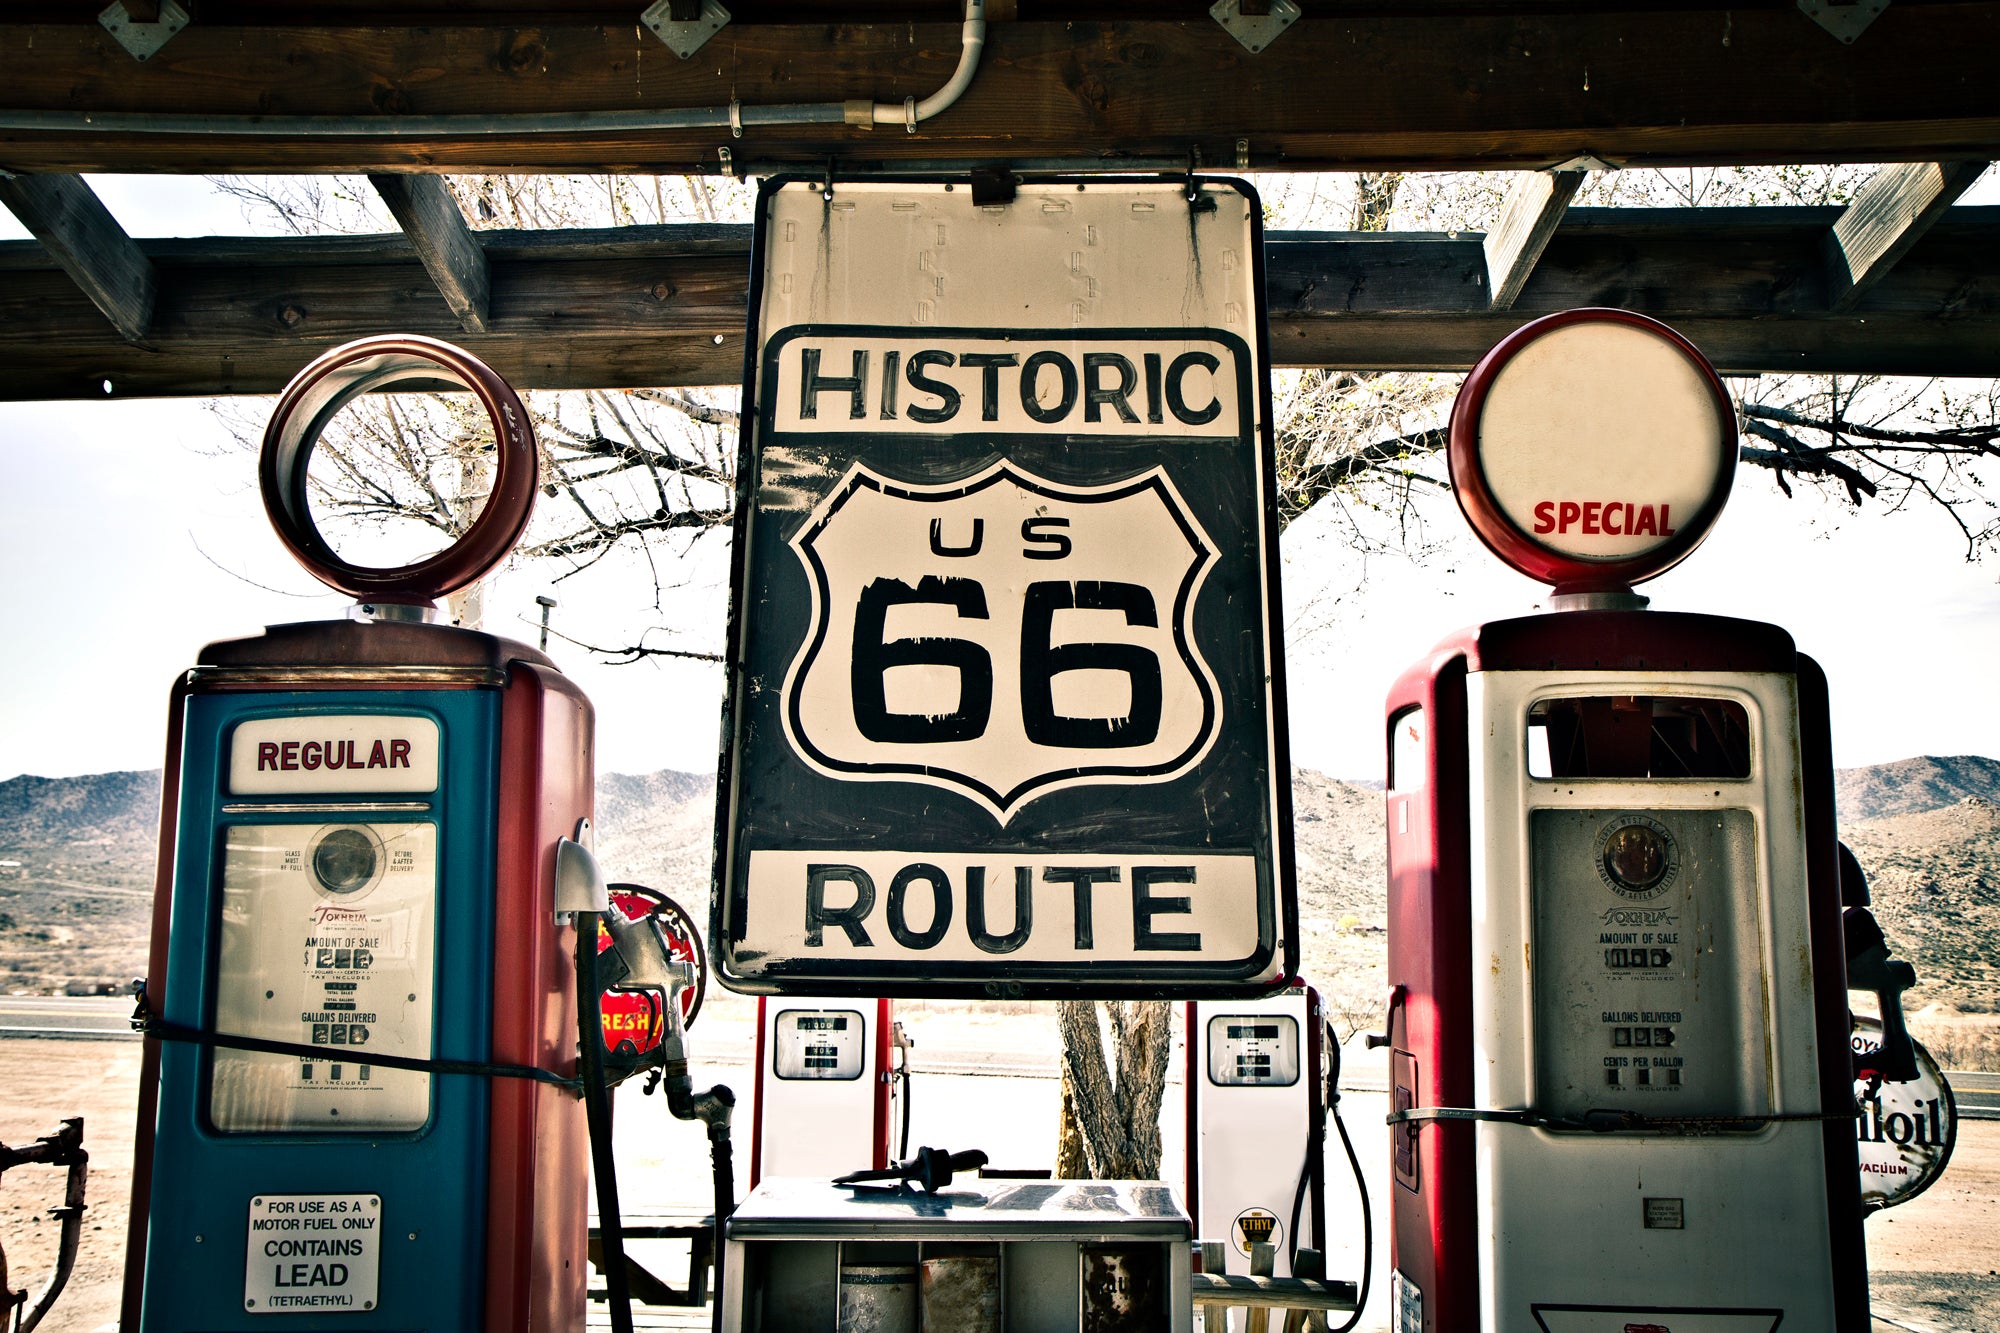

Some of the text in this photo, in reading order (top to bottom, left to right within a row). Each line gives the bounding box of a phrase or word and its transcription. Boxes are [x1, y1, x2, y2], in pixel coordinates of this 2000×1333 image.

[801, 347, 1222, 425] HISTORIC
[1533, 501, 1676, 537] SPECIAL
[851, 574, 1163, 749] 66
[257, 739, 411, 771] REGULAR
[804, 862, 1202, 953] ROUTE
[314, 906, 368, 926] TOKHEIM
[305, 937, 379, 948] AMOUNT OF SALE
[1600, 933, 1678, 944] AMOUNT OF SALE
[302, 1012, 377, 1023] GALLONS DELIVERED
[1602, 1011, 1682, 1023] GALLONS DELIVERED
[1603, 1056, 1683, 1067] CENTS PER GALLON
[268, 1201, 362, 1213] FOR USE AS A
[253, 1218, 376, 1230] MOTOR FUEL ONLY
[1242, 1219, 1273, 1231] ETHYL
[264, 1239, 363, 1257] CONTAINS
[275, 1263, 349, 1287] LEAD
[268, 1294, 354, 1307] (TETRAETHYL)
